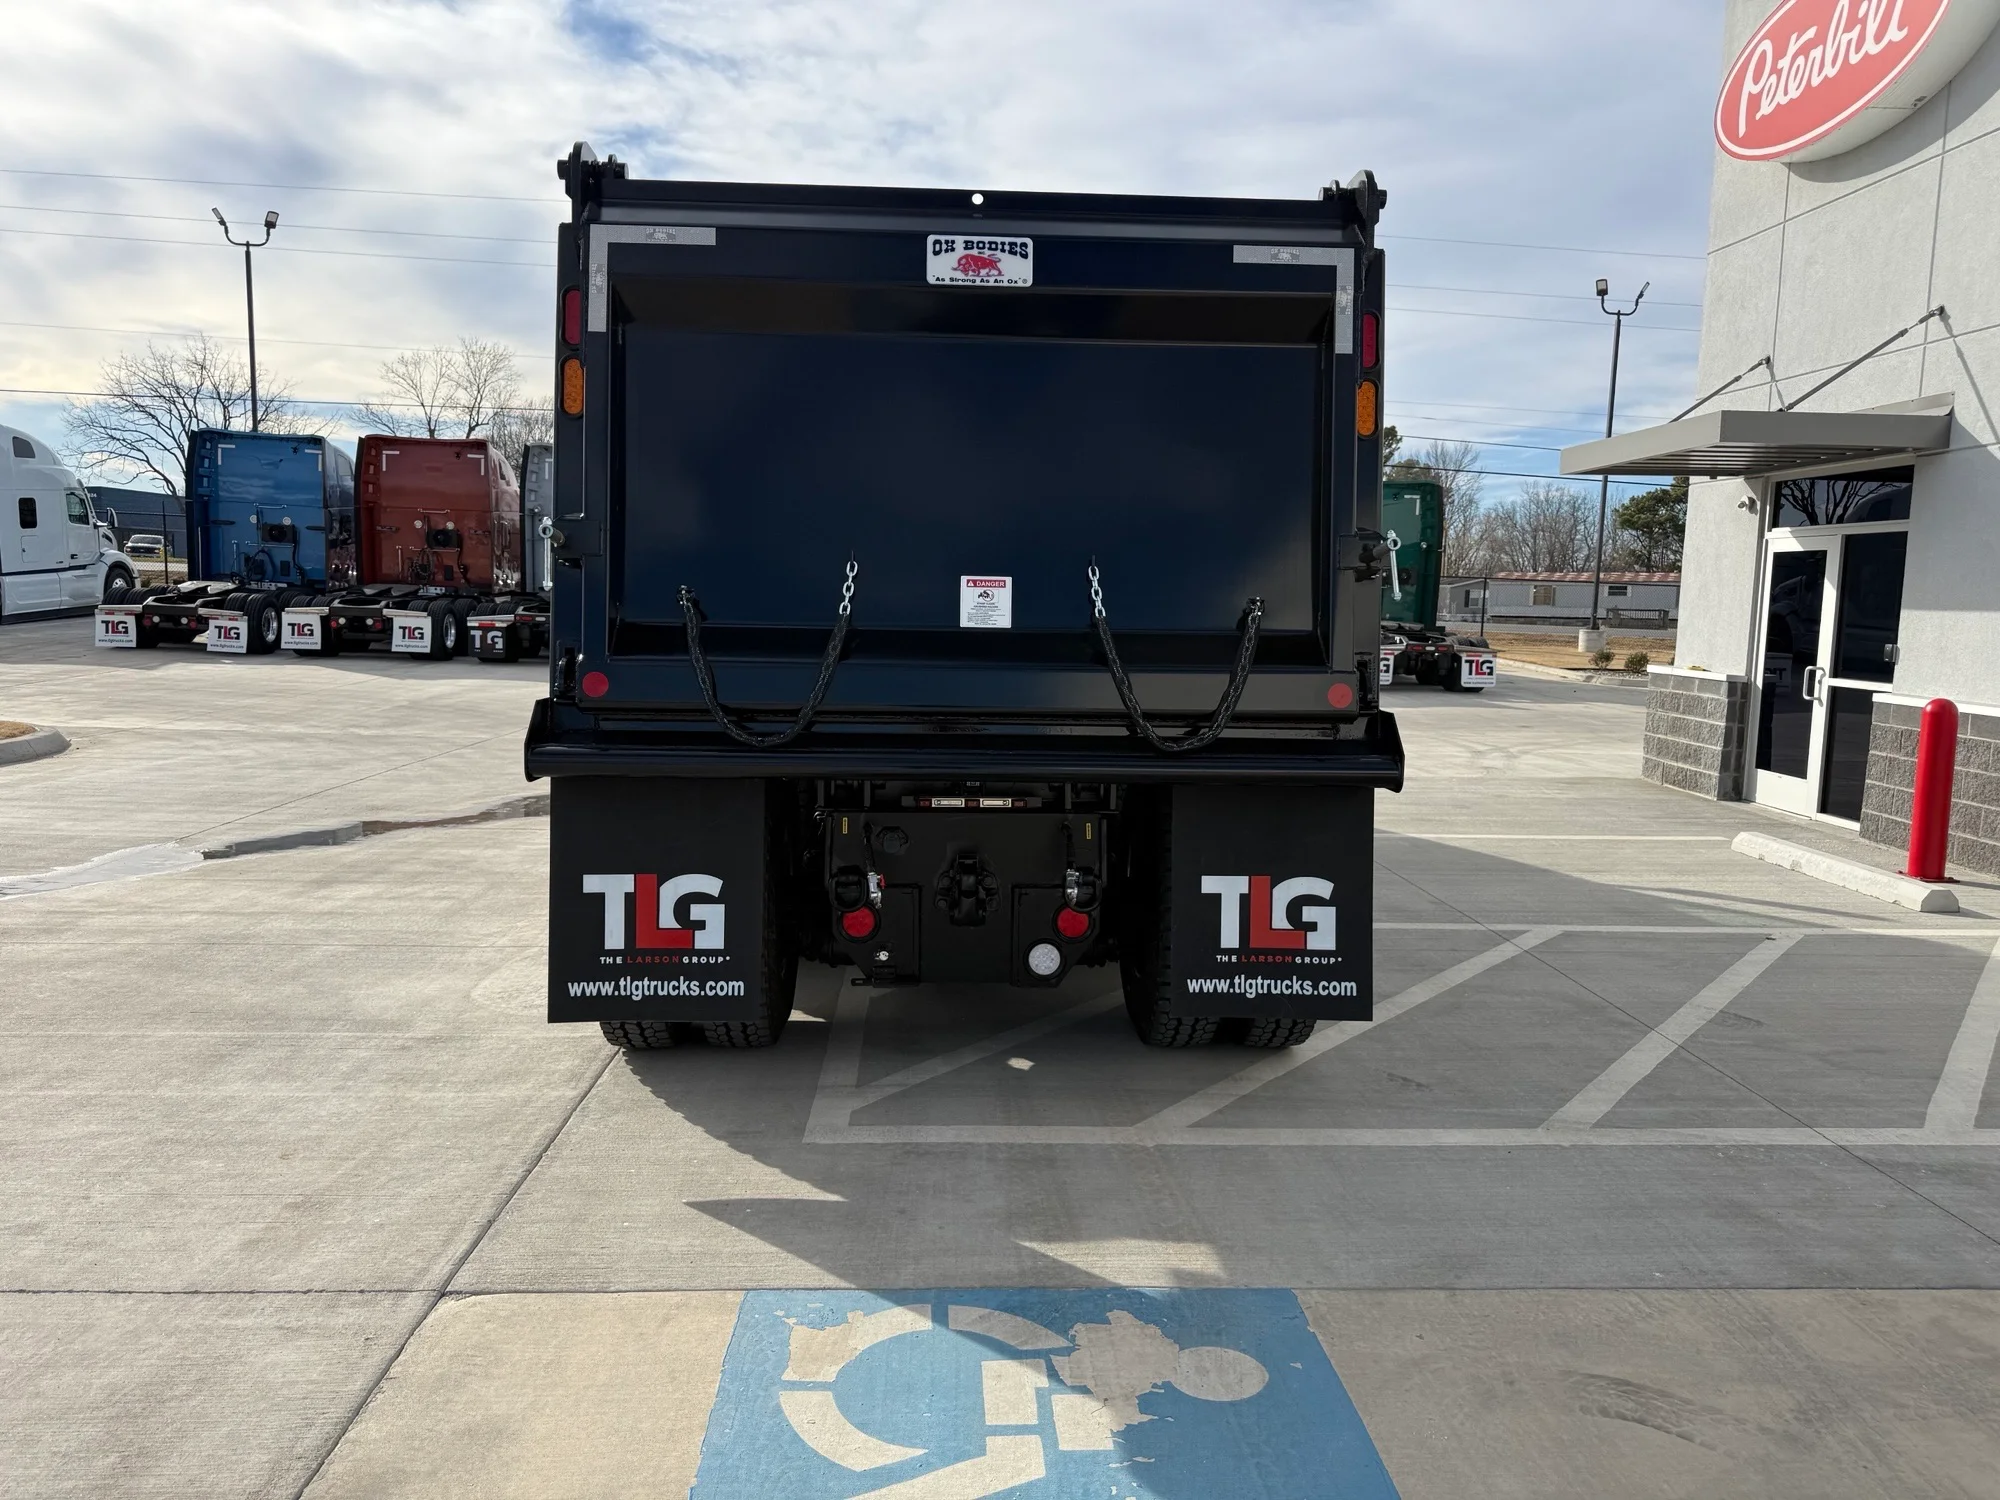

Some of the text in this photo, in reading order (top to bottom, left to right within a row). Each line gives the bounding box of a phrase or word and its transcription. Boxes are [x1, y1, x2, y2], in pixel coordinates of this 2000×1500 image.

[932, 239, 1028, 260] OX BODIES
[101, 620, 128, 634] TLG
[214, 625, 240, 640] TLG
[288, 623, 314, 636] TLG
[399, 626, 424, 640] TLG
[1465, 659, 1493, 676] TLG
[583, 874, 725, 950] TLG
[1201, 875, 1336, 951] TLG
[1216, 955, 1238, 963] THE
[1242, 955, 1292, 963] LARSON
[568, 976, 745, 1001] www.tlgtrucks.com
[1187, 975, 1357, 999] www.tlgtrucks.com
